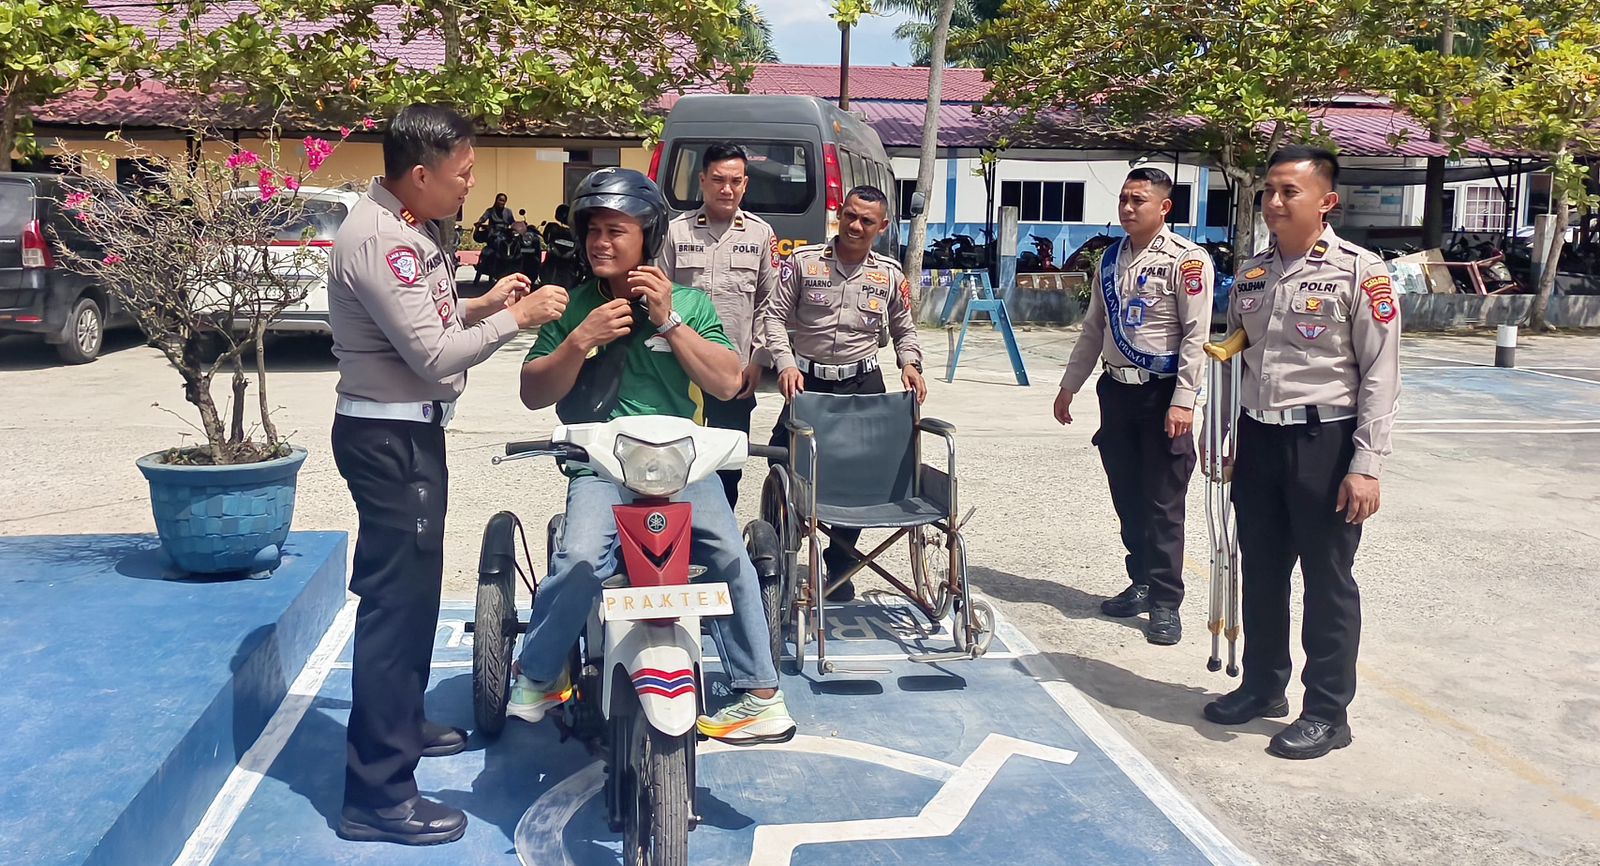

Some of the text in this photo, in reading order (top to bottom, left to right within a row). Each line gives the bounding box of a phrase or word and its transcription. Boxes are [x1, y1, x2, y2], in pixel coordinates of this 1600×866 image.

[733, 245, 758, 254] POLRI
[1140, 266, 1166, 276] POLRI
[804, 279, 832, 288] JUARNO
[1299, 281, 1337, 293] POLRI
[861, 284, 888, 298] POLRI
[1118, 340, 1146, 366] PRIMA
[606, 591, 729, 611] PRAKTEK
